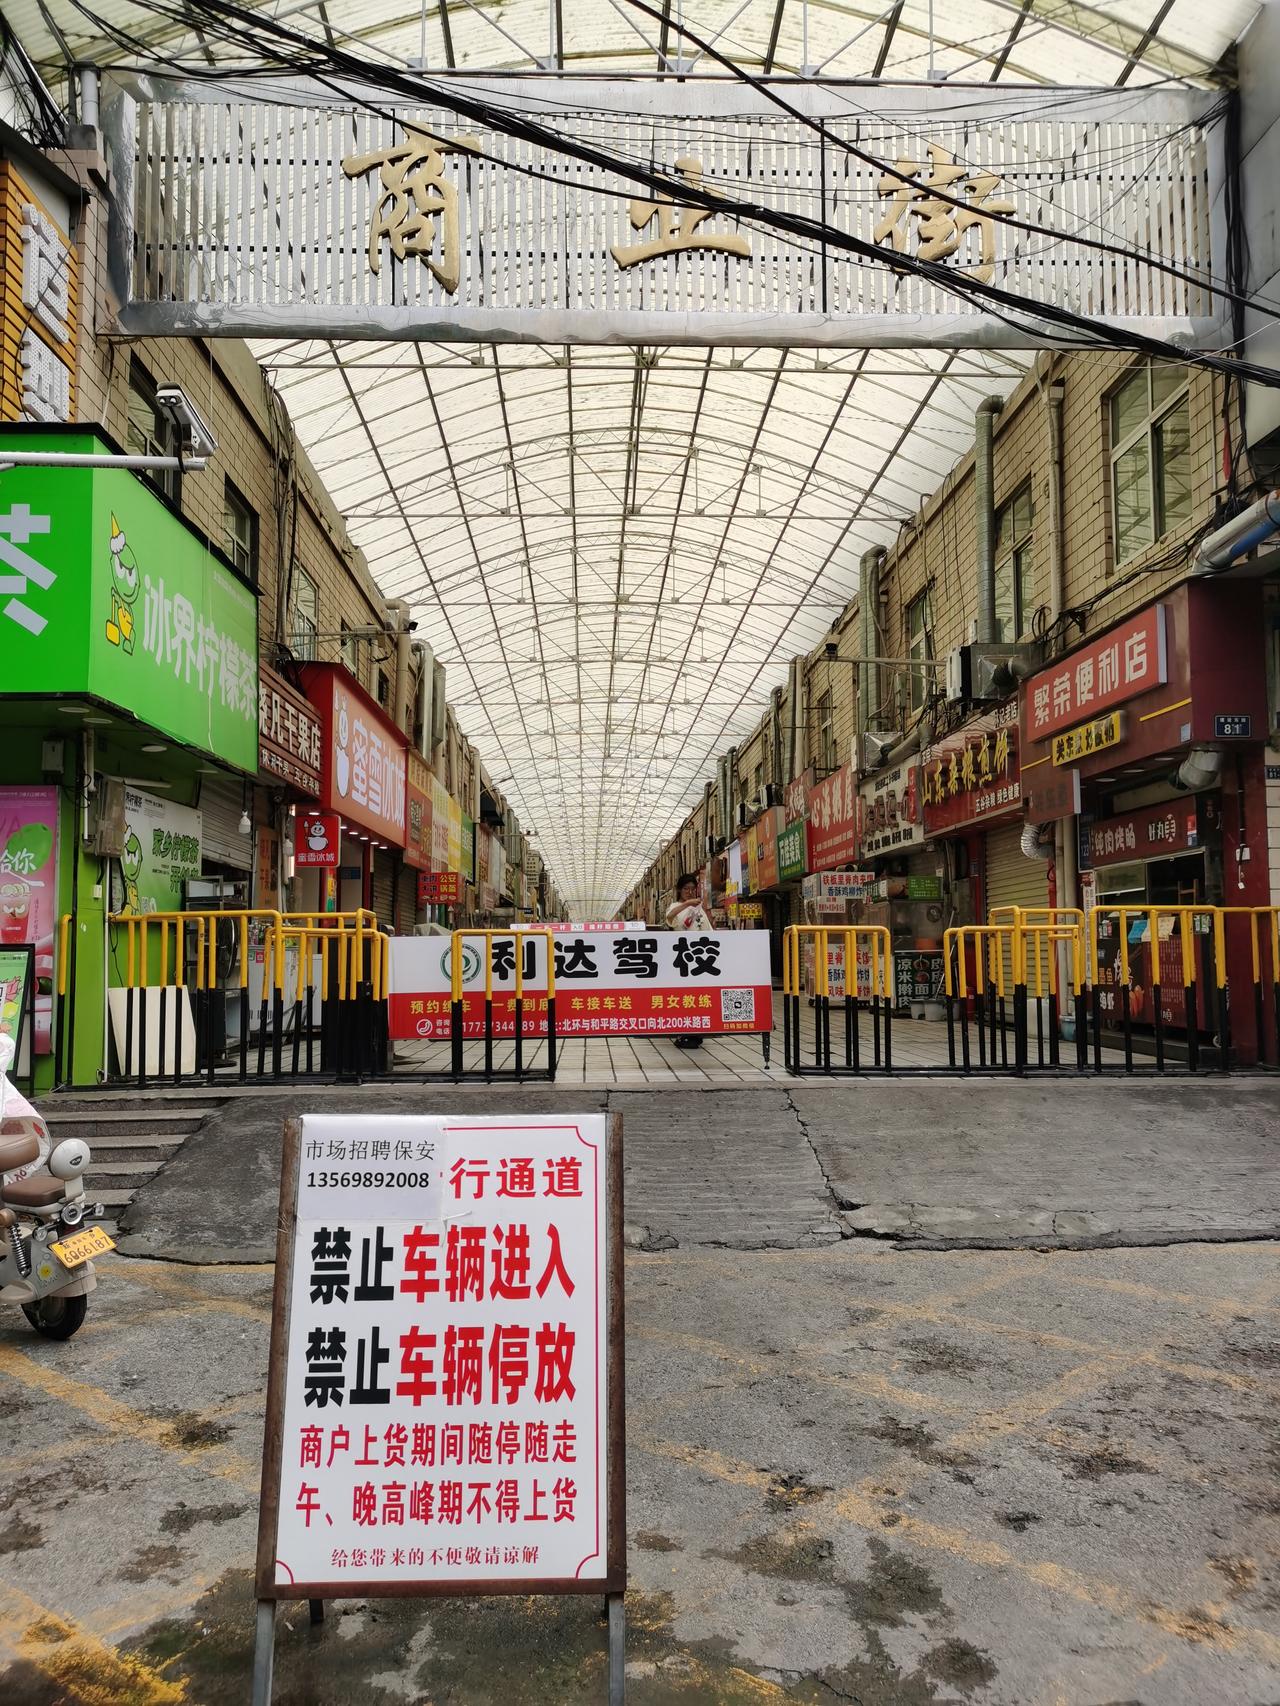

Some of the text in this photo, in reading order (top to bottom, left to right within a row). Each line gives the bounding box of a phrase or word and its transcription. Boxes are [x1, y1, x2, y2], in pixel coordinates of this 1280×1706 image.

[341, 121, 1016, 295] 商业街
[143, 574, 257, 721] 冰界柠檬茶
[1033, 630, 1147, 728] 繁荣便利店
[352, 718, 405, 830] 蜜雪冰城
[297, 853, 335, 863] 蜜雪冰城
[491, 936, 721, 980] 利达驾校
[462, 1015, 711, 1032] 177334489 地:北环与和平路交叉口向北200米路西
[571, 996, 633, 1011] 车接车送
[651, 994, 712, 1009] 男女教练
[305, 1139, 436, 1162] 市场招聘保安
[306, 1172, 430, 1189] 13569892008
[440, 1157, 584, 1199] 行通道
[309, 1223, 575, 1305] 禁止车辆进入
[304, 1322, 577, 1408] 禁止车辆停放
[299, 1419, 577, 1469] 商户上货期间随停随走
[295, 1477, 577, 1528] 午、晚高峰期不得上货
[331, 1546, 540, 1568] 给您带来的不便敬请谅解
